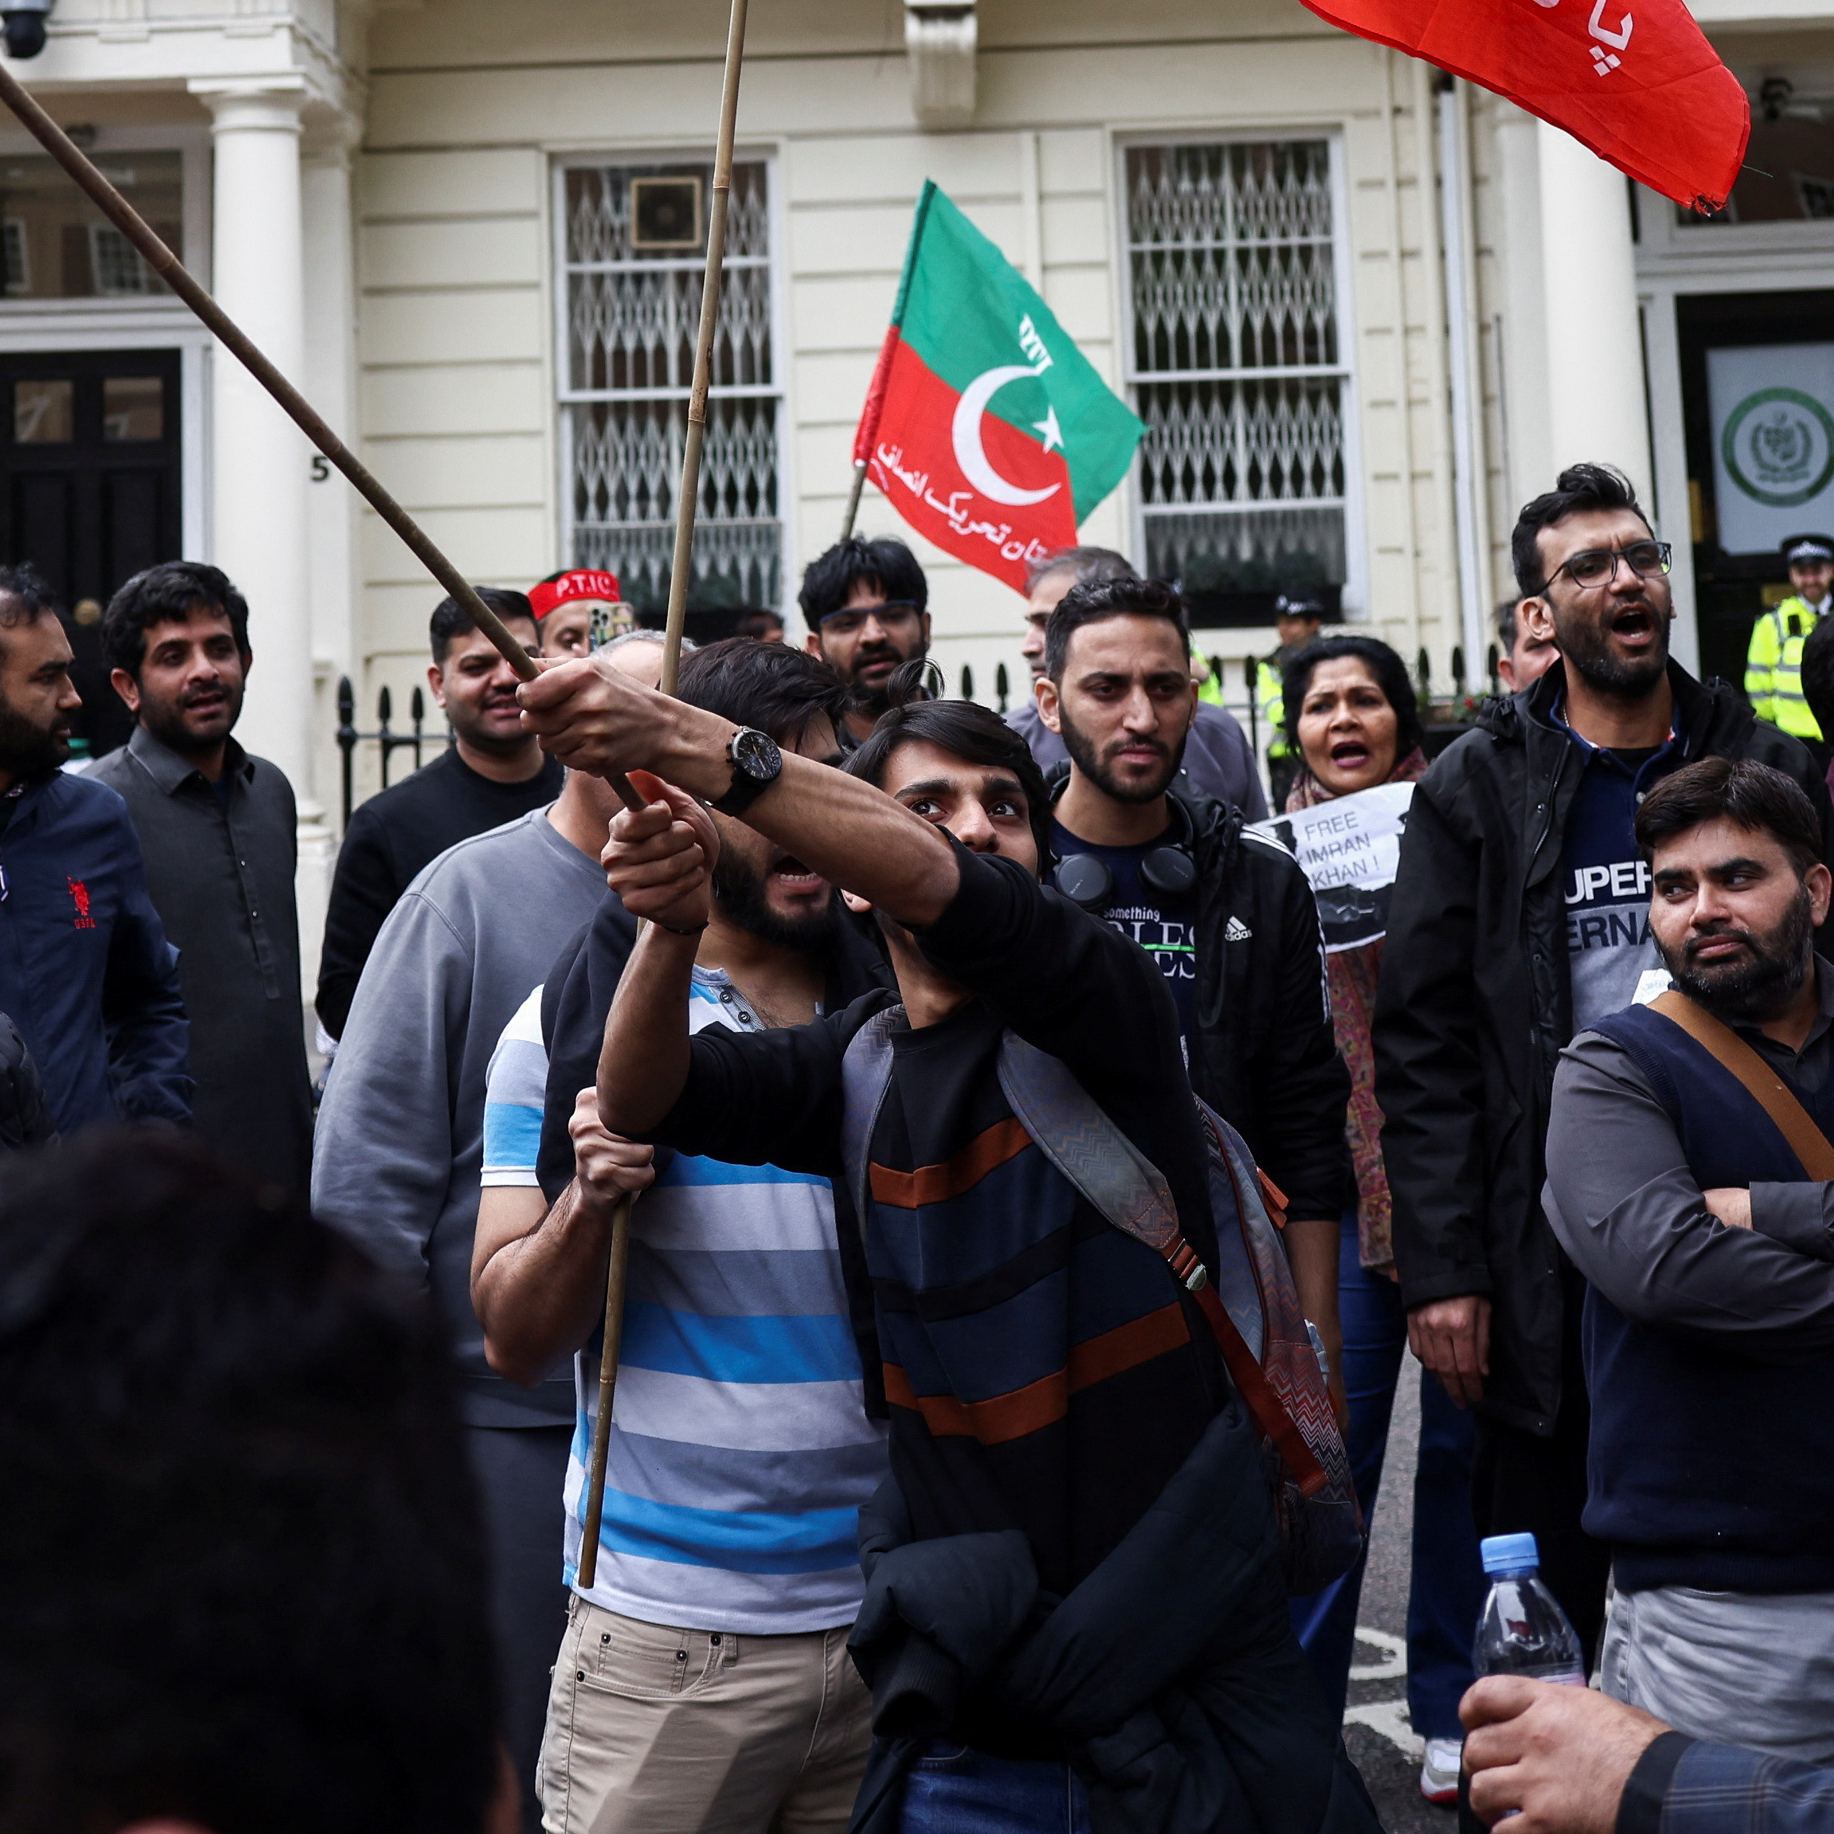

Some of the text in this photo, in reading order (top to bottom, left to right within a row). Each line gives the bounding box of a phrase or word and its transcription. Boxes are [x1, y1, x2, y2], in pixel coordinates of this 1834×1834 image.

[924, 488, 1013, 546] تحریک
[1304, 811, 1359, 841] FREE
[1305, 833, 1371, 864] IMRAN
[1311, 858, 1368, 888] KHAN
[1103, 906, 1160, 924] something
